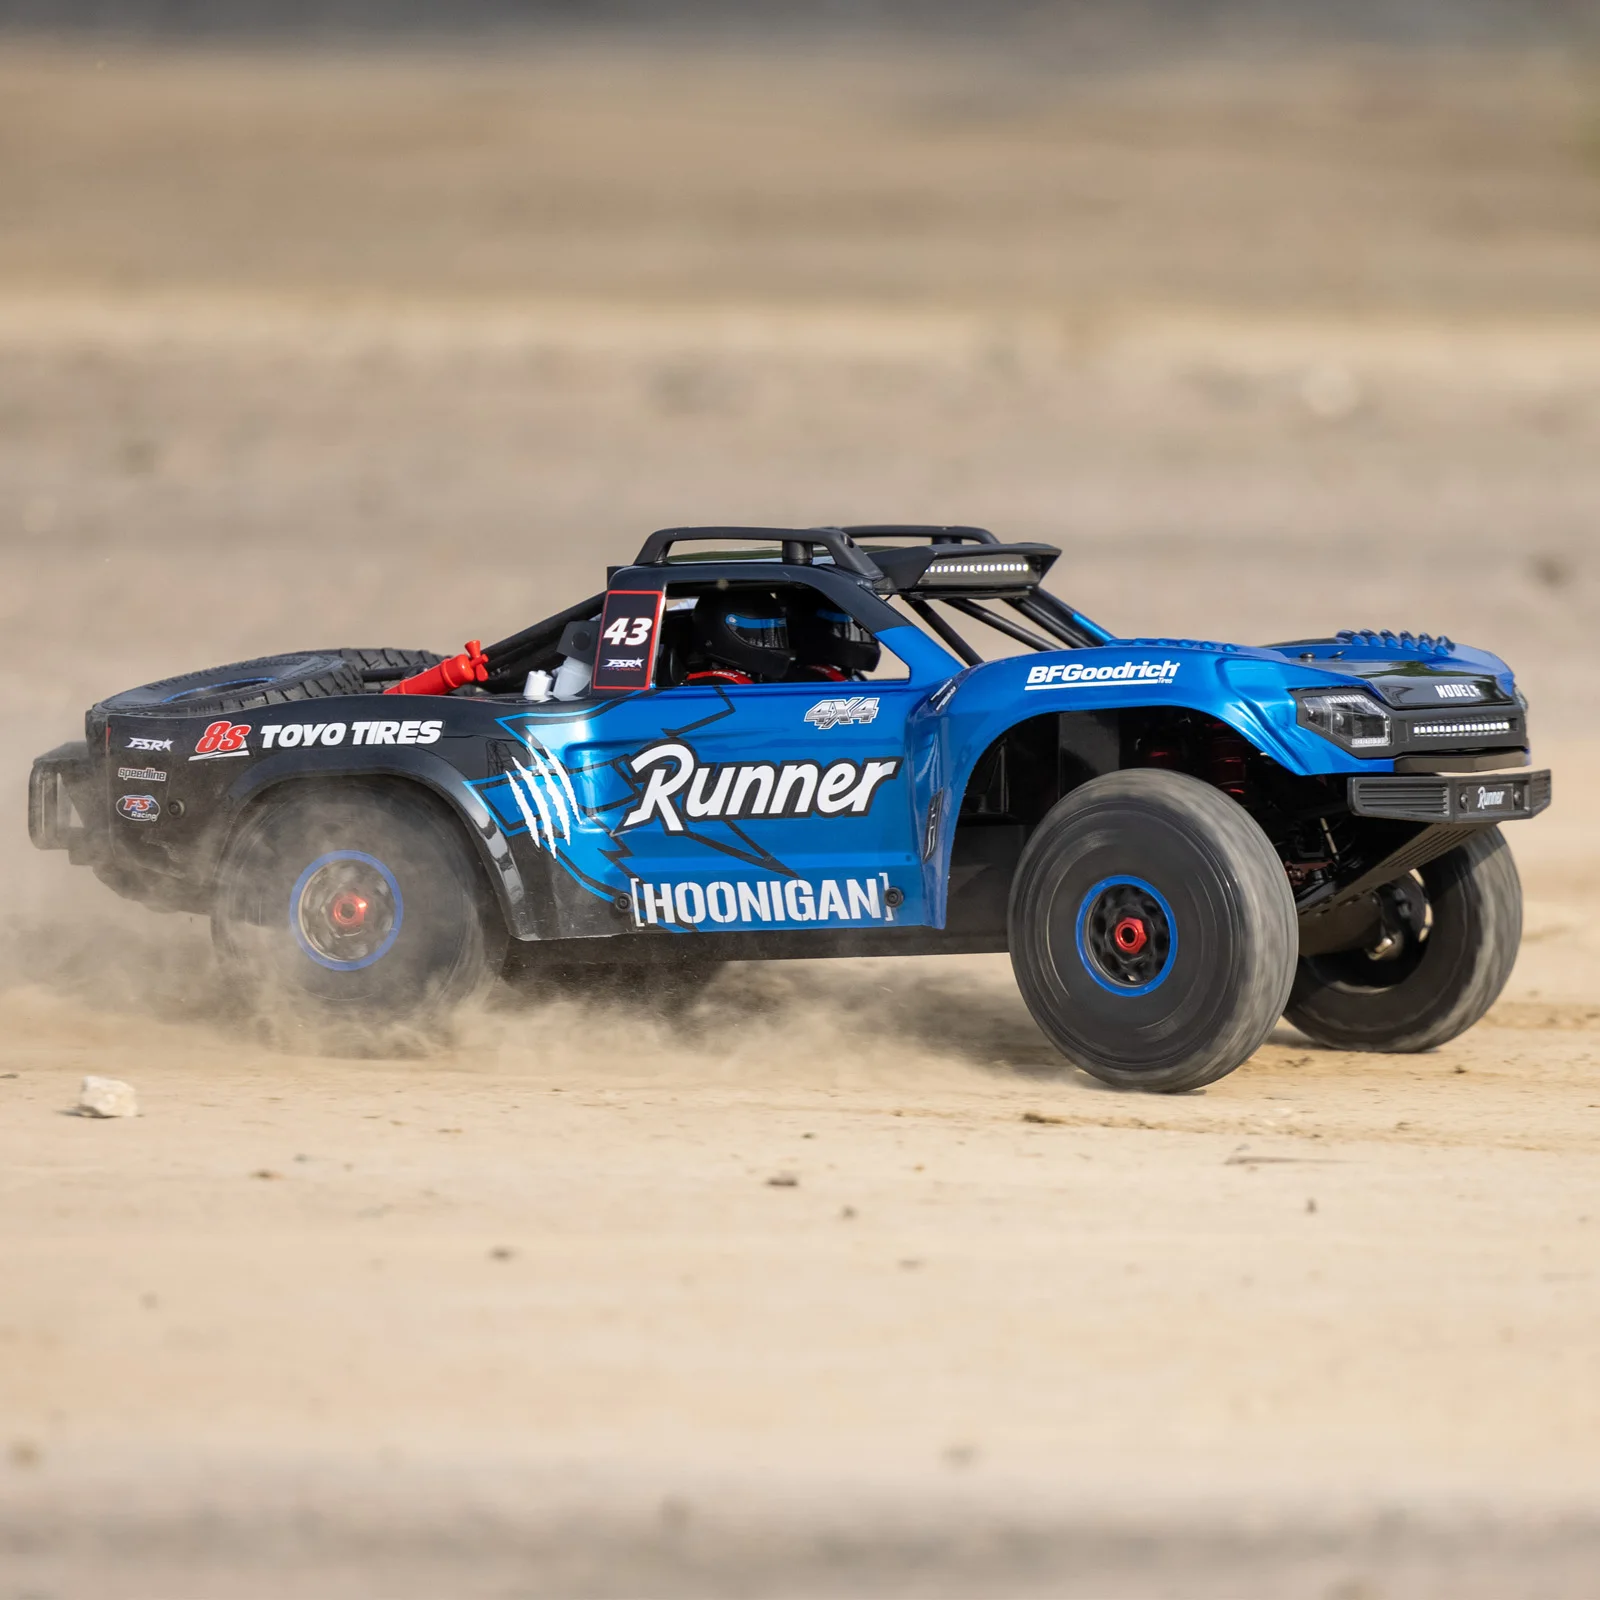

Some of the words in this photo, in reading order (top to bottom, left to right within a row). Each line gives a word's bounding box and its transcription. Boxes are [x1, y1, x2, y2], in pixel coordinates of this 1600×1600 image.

[603, 617, 653, 646] 43
[1026, 660, 1179, 684] BFGoodrich
[260, 722, 347, 748] TOYO
[351, 720, 443, 745] TIRES
[118, 767, 167, 781] speedline
[623, 743, 897, 832] Runner
[1477, 786, 1505, 810] Runner
[131, 811, 158, 822] Racing
